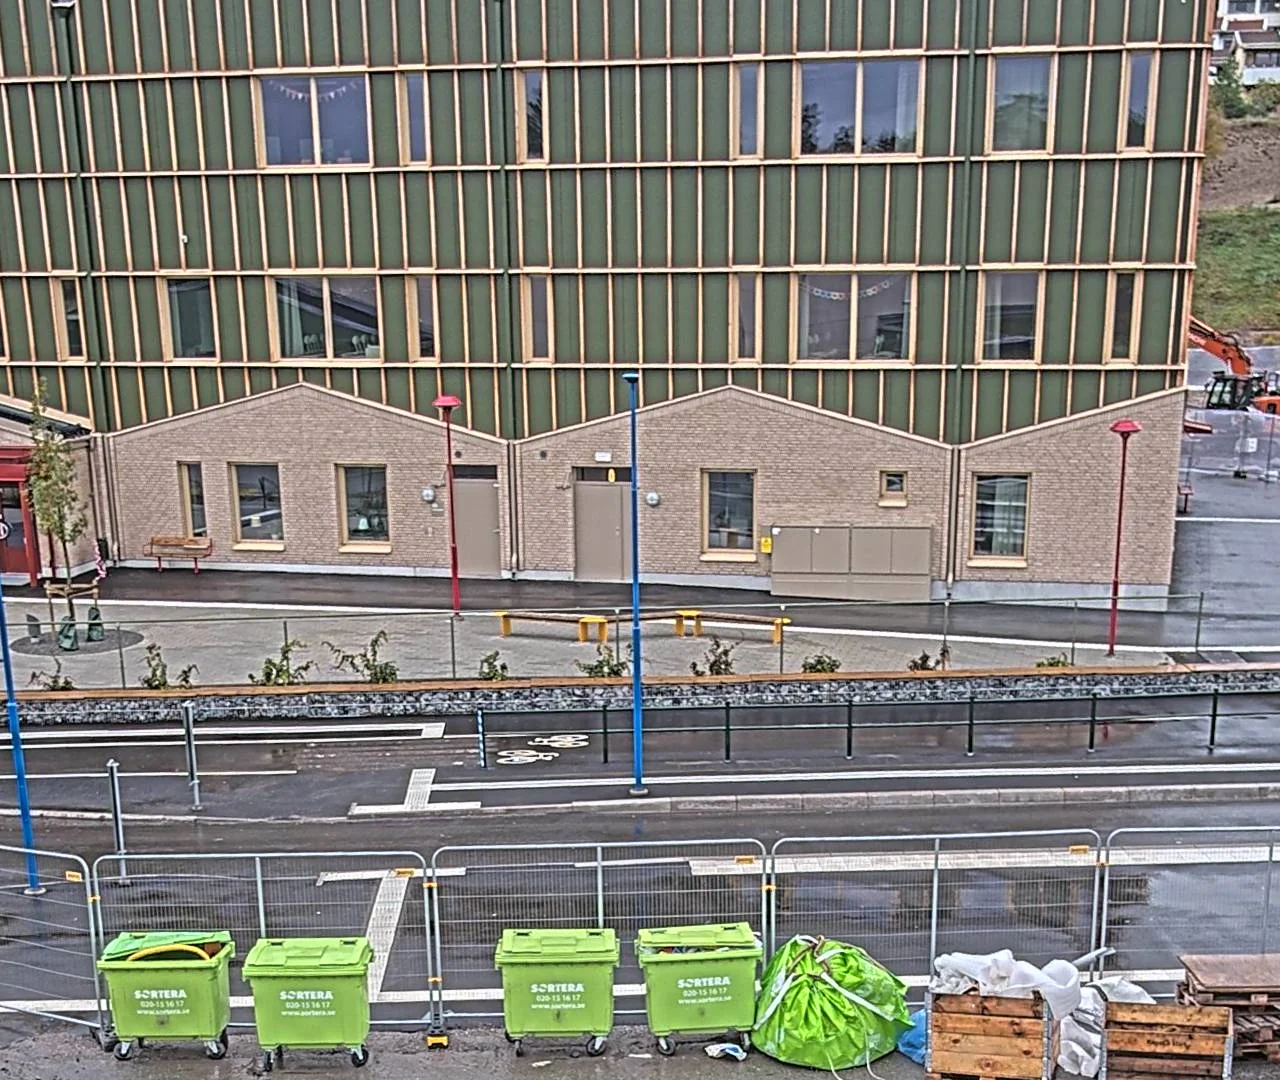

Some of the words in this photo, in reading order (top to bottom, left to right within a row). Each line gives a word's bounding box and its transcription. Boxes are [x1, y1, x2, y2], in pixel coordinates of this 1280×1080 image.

[677, 976, 731, 988] SORTERA
[530, 983, 585, 993] SORTERA
[134, 989, 188, 999] SORTERA
[280, 990, 334, 1000] SORTERA
